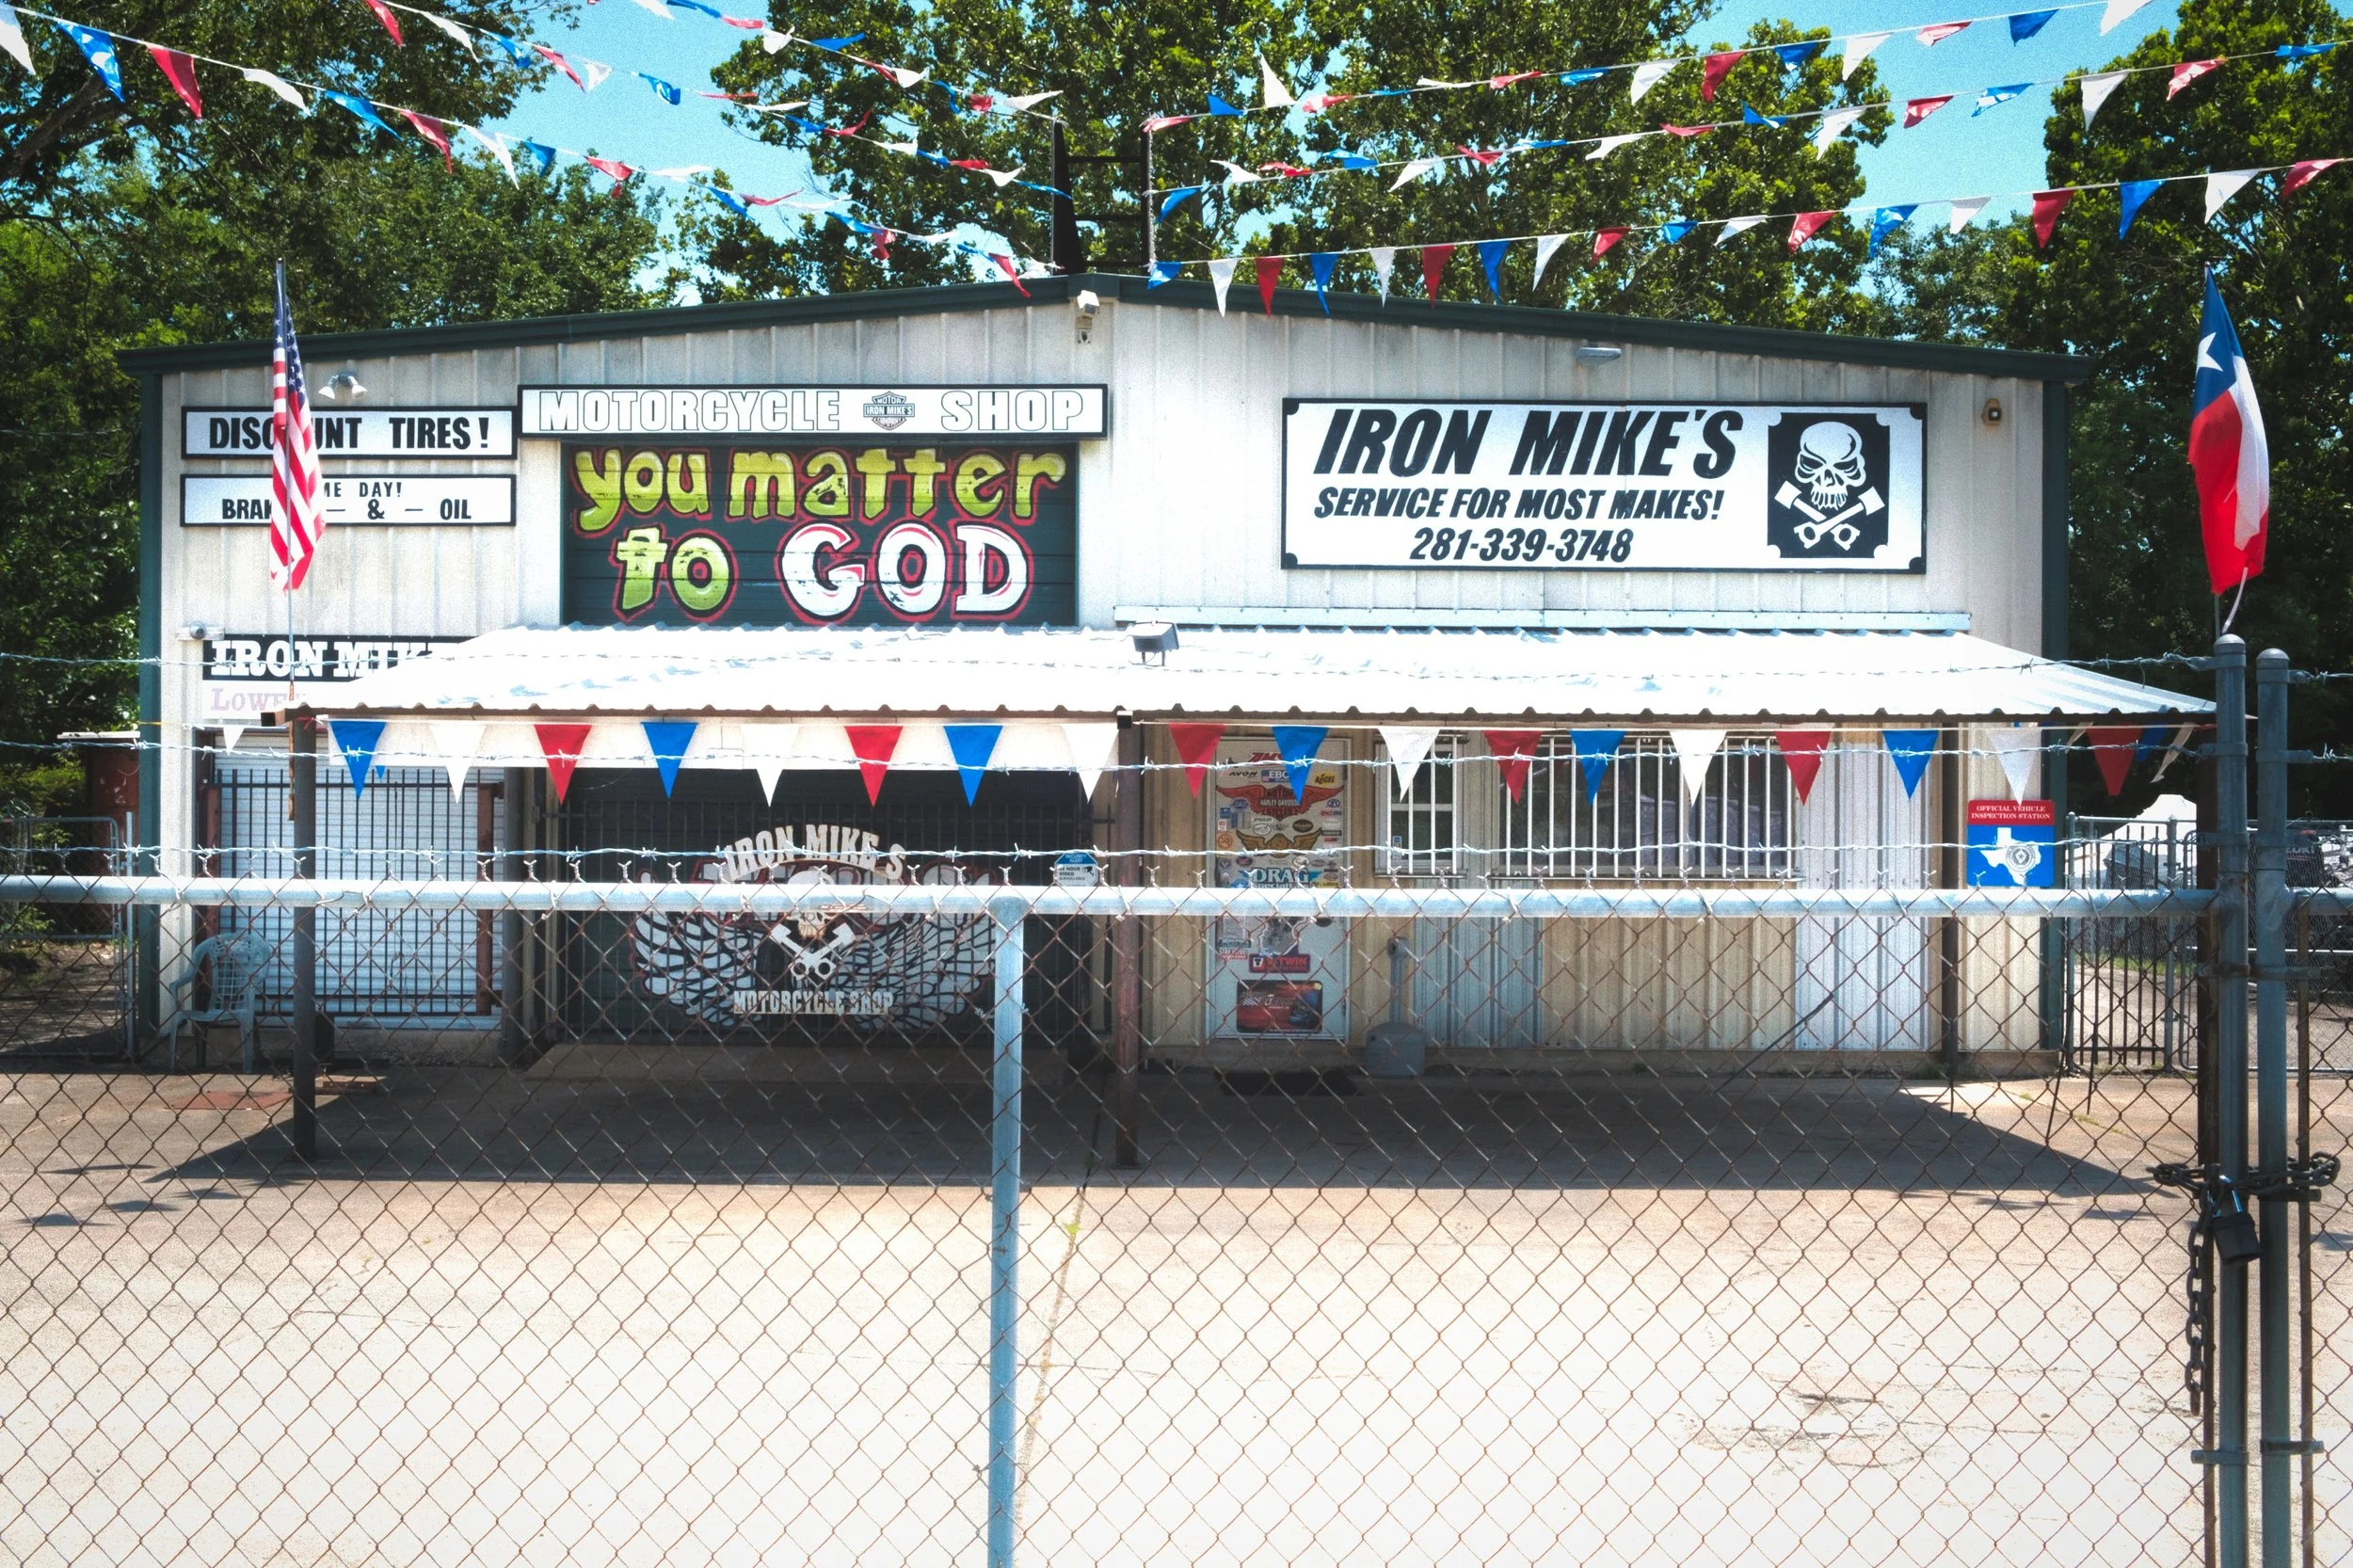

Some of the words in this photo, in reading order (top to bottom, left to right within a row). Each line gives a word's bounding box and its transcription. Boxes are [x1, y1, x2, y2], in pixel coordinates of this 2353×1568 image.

[539, 391, 840, 432] MOTORCYCLE
[941, 391, 1083, 432] SHOP
[866, 406, 885, 415] IRON
[210, 417, 362, 450] DISCUNT
[1313, 408, 1493, 477] IRON
[1509, 408, 1744, 479] MIKE'S
[360, 482, 402, 498] DAY!
[573, 447, 711, 533] you
[727, 446, 1067, 520] matter
[1314, 487, 1449, 519] SERVICE
[1449, 488, 1511, 520] FOR
[1513, 488, 1606, 520] MOST
[1608, 489, 1724, 520] MAKES!
[367, 499, 385, 520] &
[440, 499, 472, 520] OIL
[1409, 527, 1634, 563] 281-339-3748
[612, 523, 733, 616] to
[779, 520, 1030, 618] GOD
[211, 640, 328, 678] IRON
[723, 824, 794, 881] IRON
[1253, 868, 1309, 883] DRAG
[734, 990, 845, 1014] MOTORCYCLE
[849, 991, 894, 1014] SHOP
